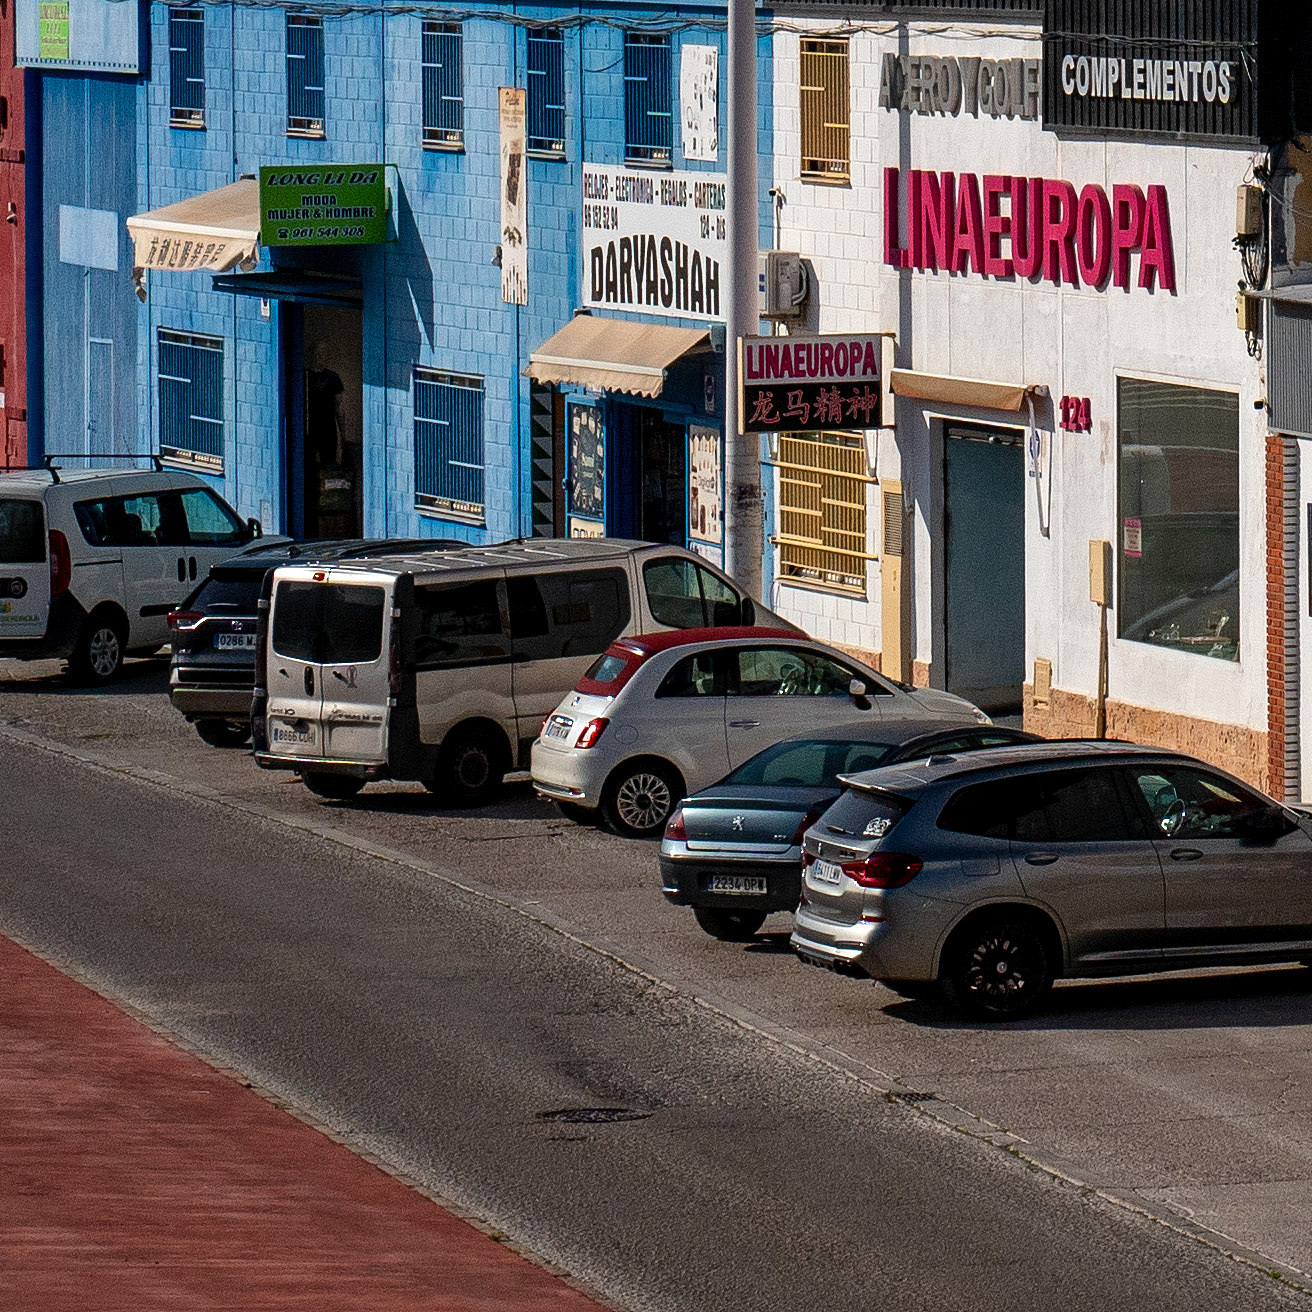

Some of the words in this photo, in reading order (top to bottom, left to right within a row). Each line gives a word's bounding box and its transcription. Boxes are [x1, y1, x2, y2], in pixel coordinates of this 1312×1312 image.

[1061, 54, 1231, 103] COMPLEMENTOS
[267, 173, 320, 186] LONG
[324, 172, 344, 185] LI
[349, 171, 379, 184] DA
[584, 173, 608, 200] RELOJES
[660, 179, 687, 207] REGALOS
[694, 182, 726, 210] CARTERAS
[267, 208, 310, 220] MUJER
[325, 207, 375, 218] HOMBRE
[301, 195, 337, 206] MODA
[883, 167, 1177, 294] LINAEUROPA
[591, 234, 720, 316] DARYASHAH
[747, 341, 877, 379] LINAEUROPA
[749, 385, 878, 425] 龙马精神
[1059, 395, 1092, 433] 124
